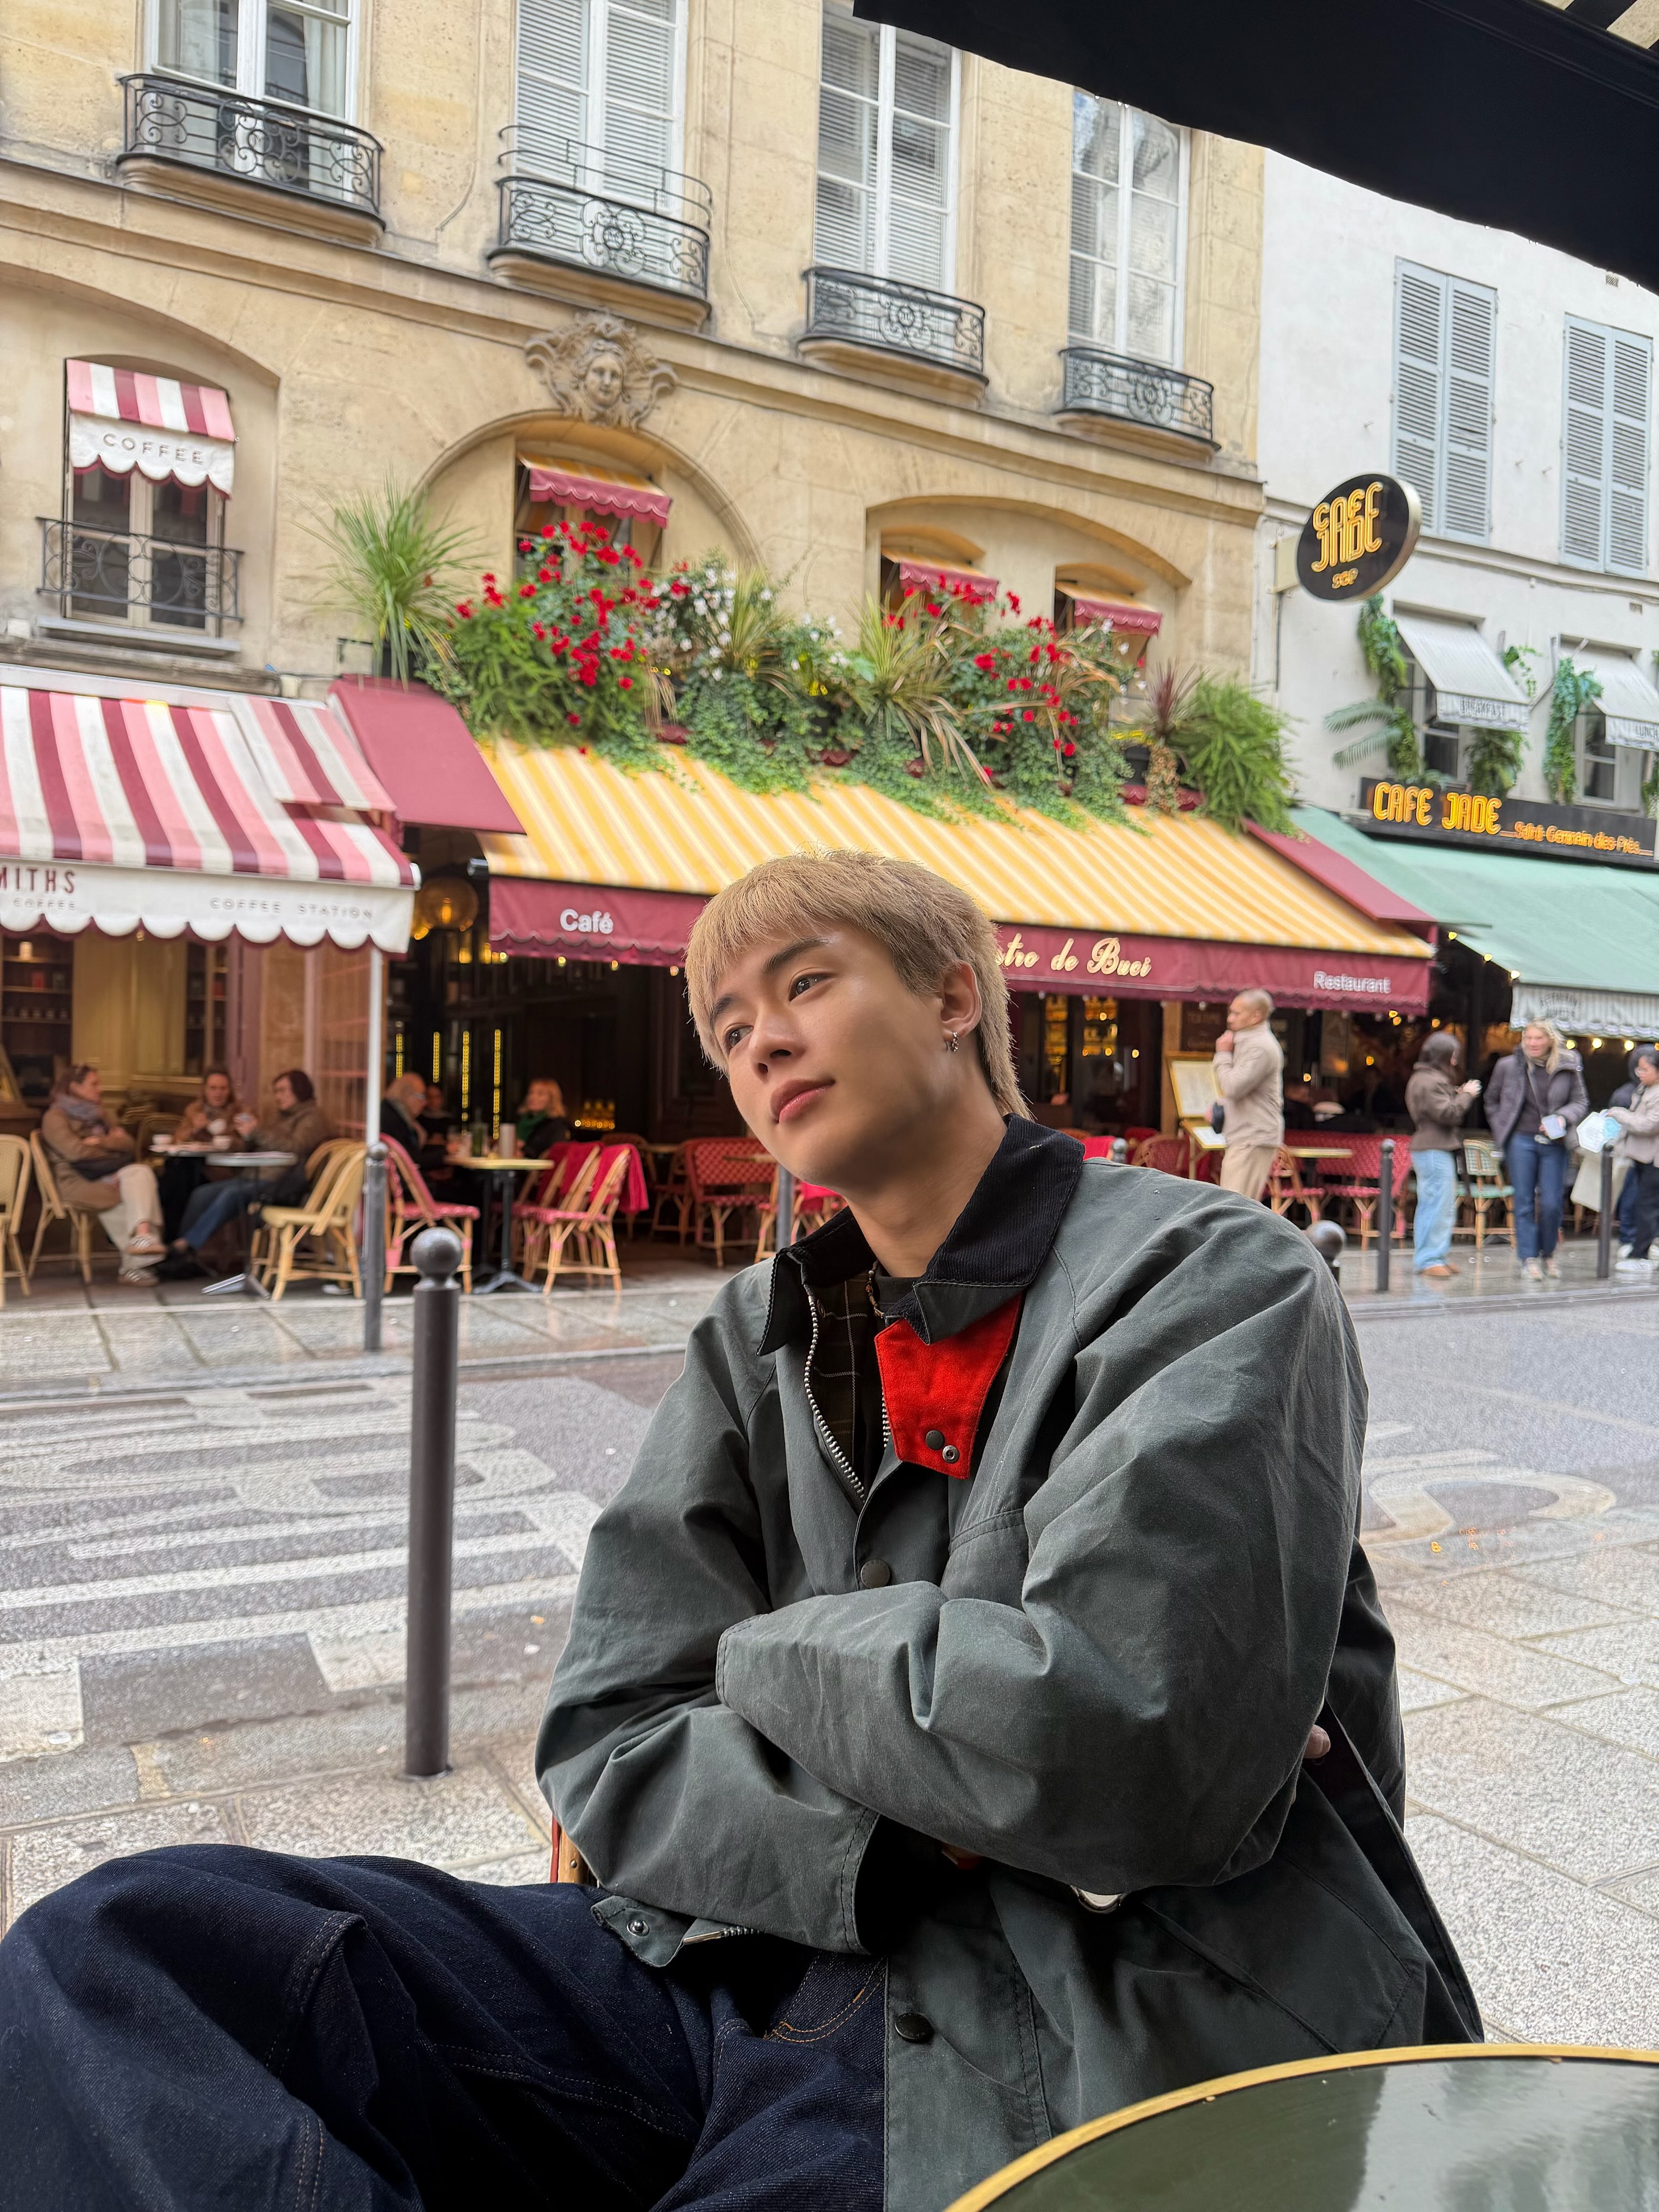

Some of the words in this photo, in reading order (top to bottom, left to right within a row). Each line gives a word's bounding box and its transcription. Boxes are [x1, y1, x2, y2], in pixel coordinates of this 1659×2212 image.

[103, 434, 204, 464] COFFEE
[1373, 781, 1434, 826] CAFE
[1441, 792, 1502, 834] JADE
[13, 897, 77, 911] COFFEE
[210, 898, 281, 914] COFFEE
[298, 903, 373, 919] STATION
[560, 908, 613, 934] Café
[1051, 938, 1079, 972] de
[1087, 938, 1152, 977] Buci
[1313, 971, 1392, 994] Restaurant
